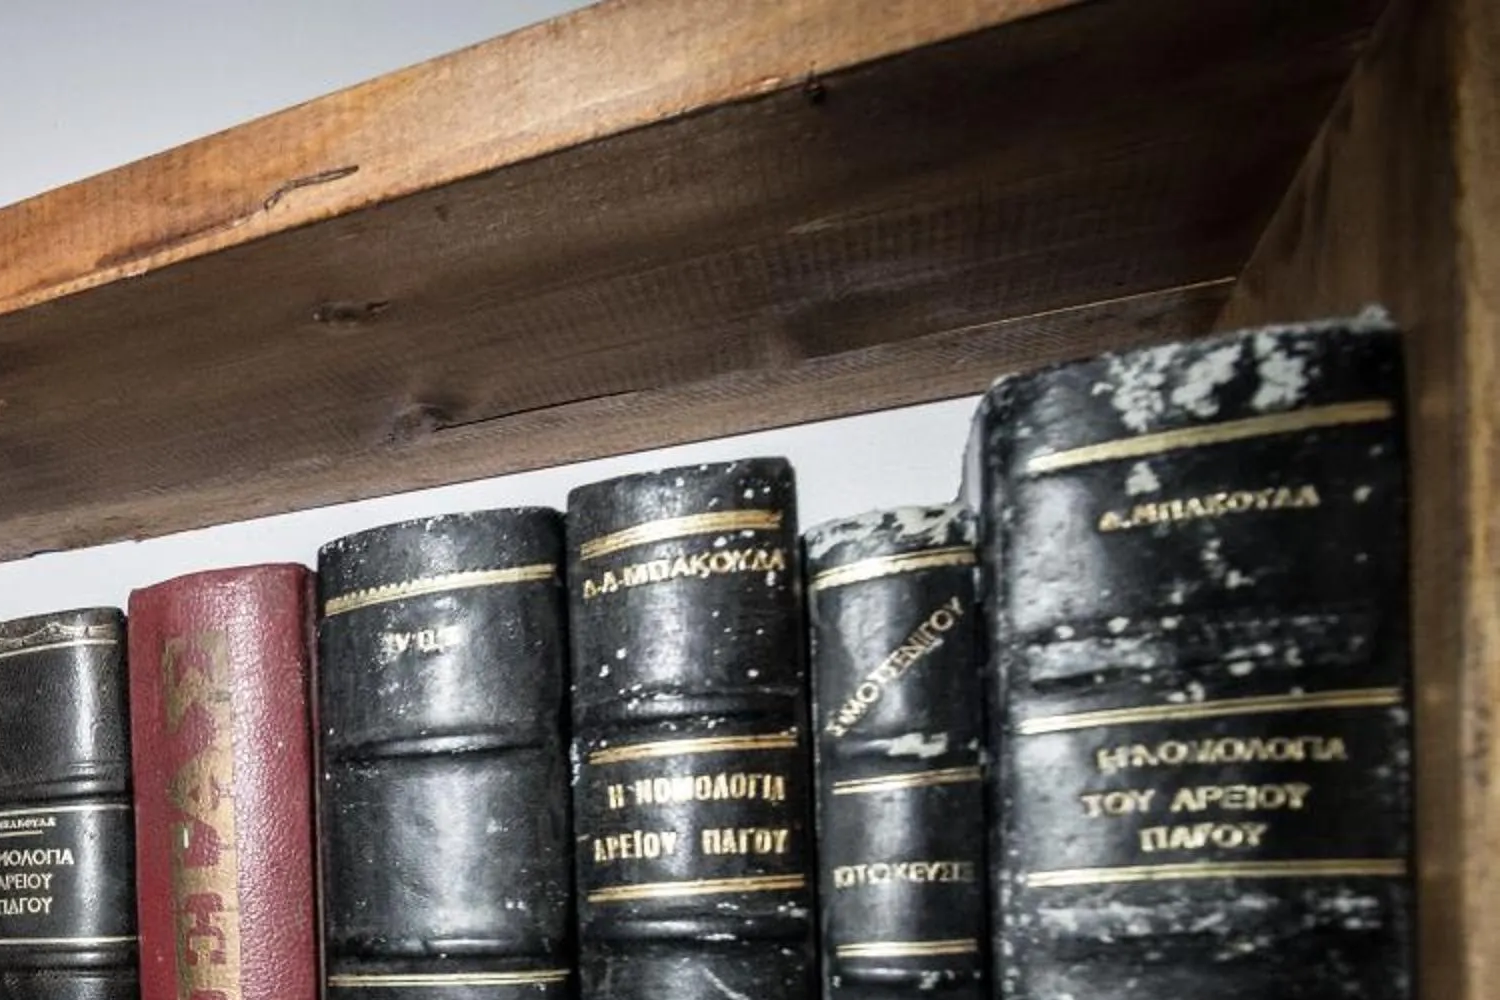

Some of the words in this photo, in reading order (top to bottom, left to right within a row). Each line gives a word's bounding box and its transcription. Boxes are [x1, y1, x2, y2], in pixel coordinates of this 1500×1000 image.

[608, 783, 625, 810] Η
[636, 772, 786, 806] ΝΟΜΟΛΟΓΙΑ
[1081, 788, 1157, 818] ΤΟΥ
[1170, 782, 1312, 813] ΑΡΕΙΟΥ
[701, 827, 789, 856] ΠΑΓΟΥ
[1138, 822, 1269, 852] ΠΑΓΟΥ
